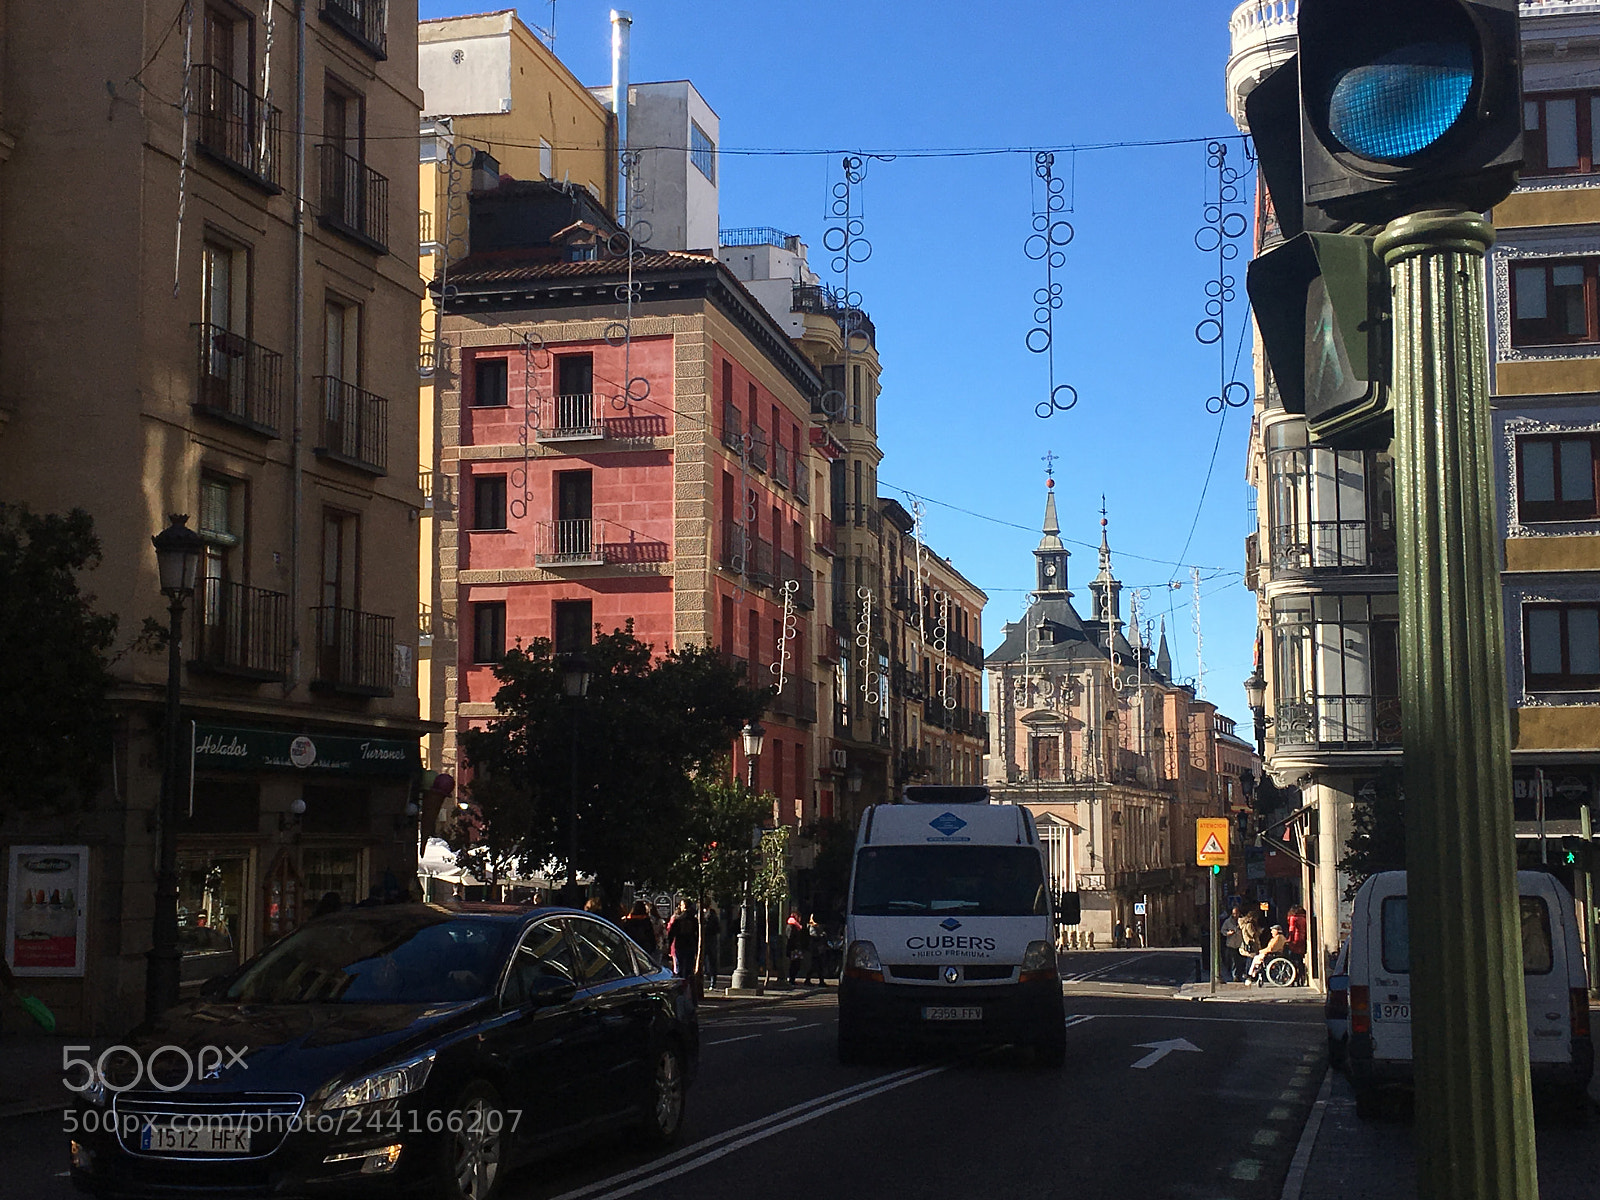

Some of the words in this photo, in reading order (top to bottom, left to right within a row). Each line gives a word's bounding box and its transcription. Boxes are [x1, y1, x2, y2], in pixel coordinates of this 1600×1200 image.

[196, 734, 248, 757] Helados
[360, 742, 406, 760] Turrones
[906, 935, 996, 951] CUBERS
[945, 949, 985, 958] PREMIUM
[158, 1128, 198, 1149] 1512
[212, 1129, 246, 1150] HFK
